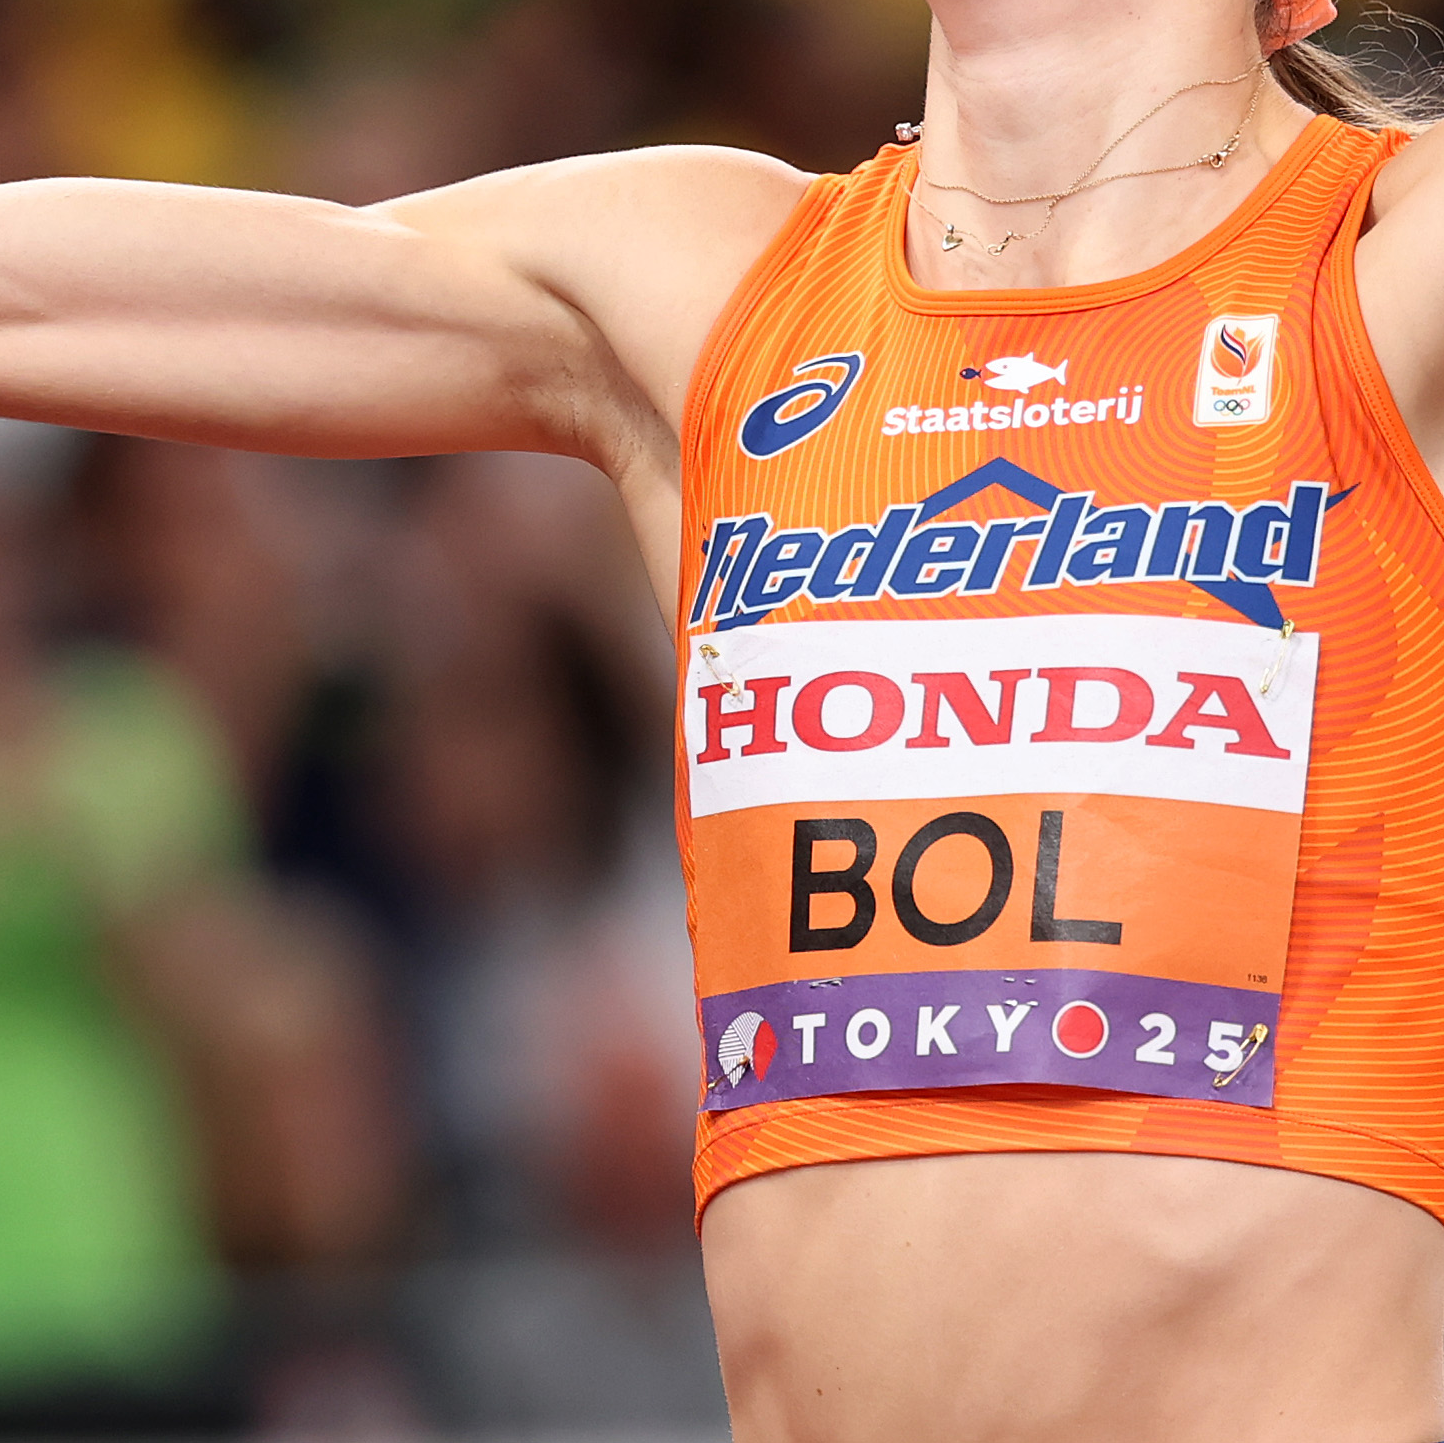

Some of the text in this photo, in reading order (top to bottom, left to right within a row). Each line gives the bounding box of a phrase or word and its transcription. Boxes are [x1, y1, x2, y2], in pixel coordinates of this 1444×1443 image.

[881, 386, 1144, 436] Staatsloterij
[1210, 385, 1256, 396] TeamNL
[696, 667, 1291, 764] HONDA
[789, 810, 1122, 953] BOL
